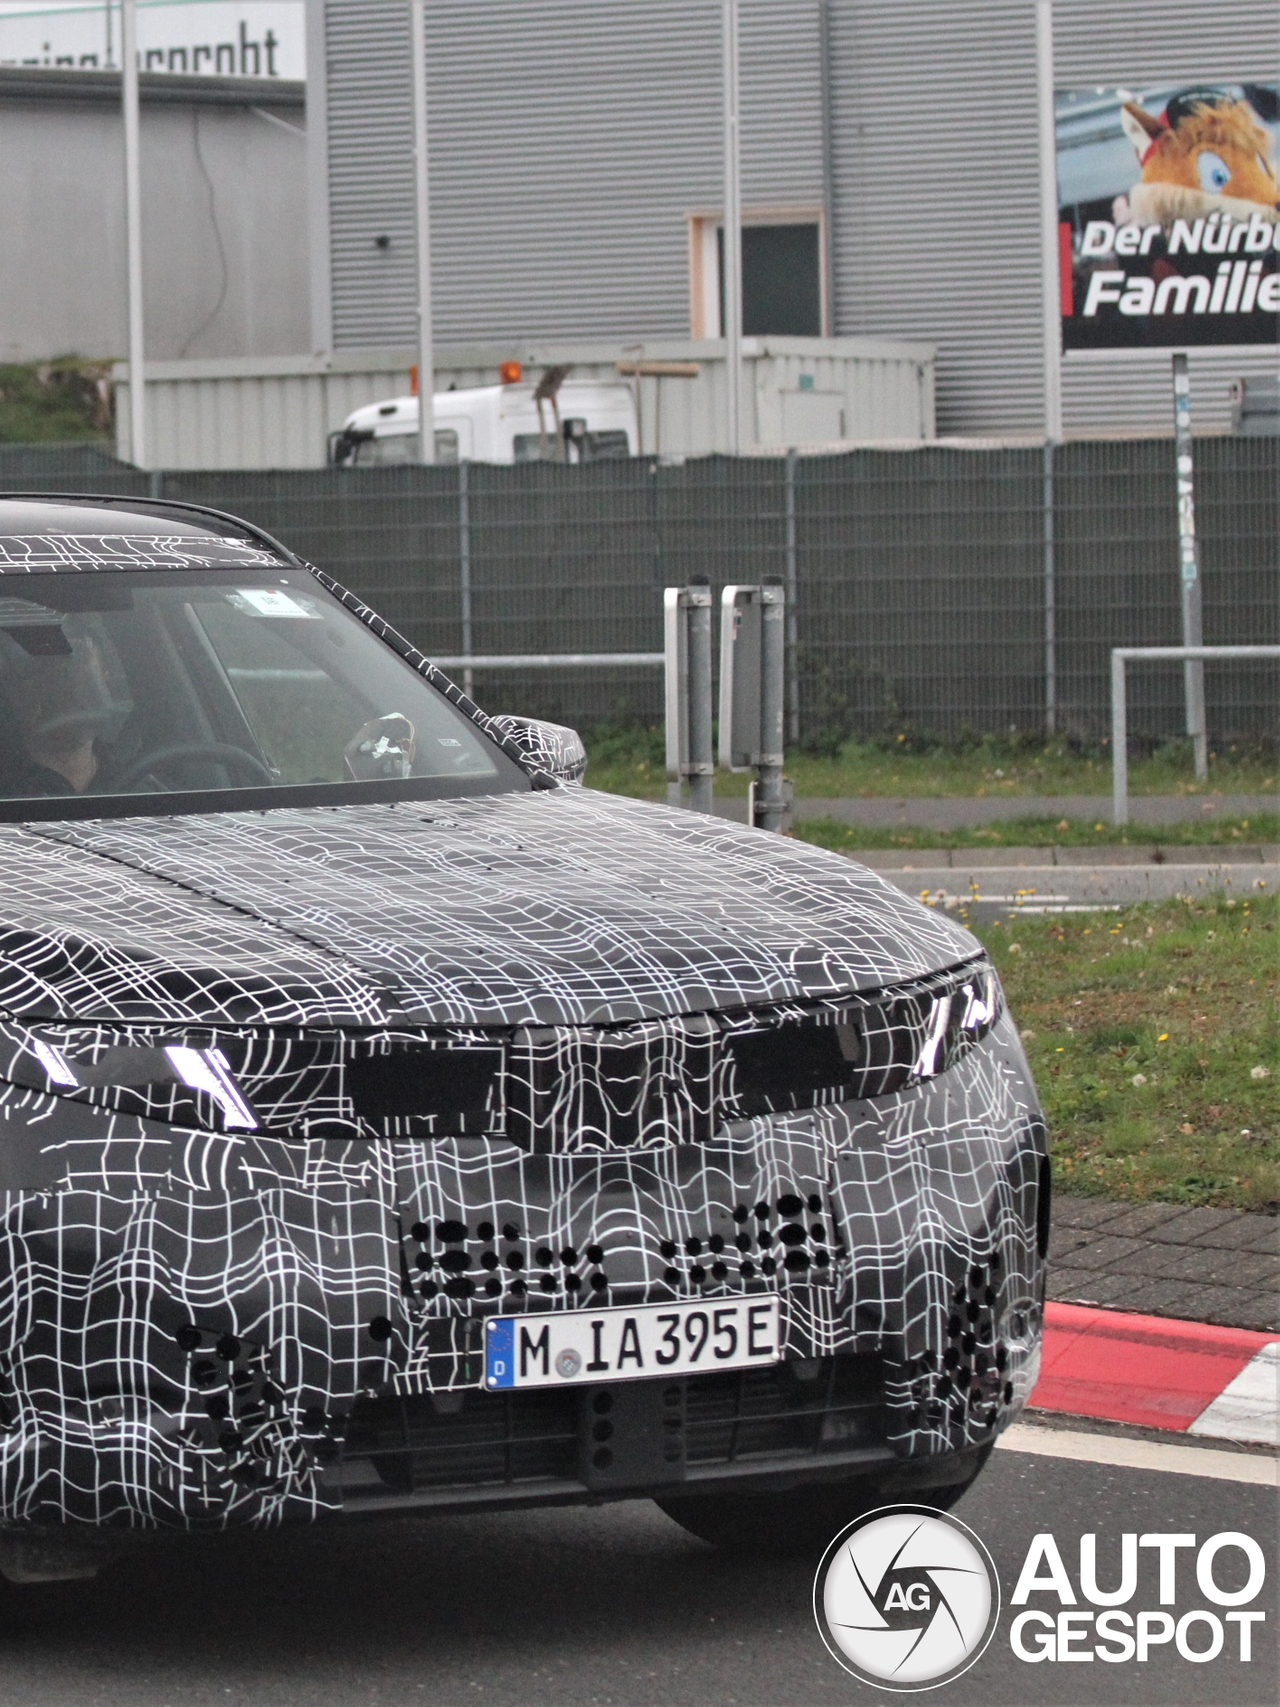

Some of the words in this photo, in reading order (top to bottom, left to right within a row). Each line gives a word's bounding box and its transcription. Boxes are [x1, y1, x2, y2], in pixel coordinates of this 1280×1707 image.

[1081, 220, 1161, 256] Der
[1167, 212, 1280, 255] Nürb
[494, 1360, 506, 1376] D
[520, 1324, 550, 1377] M
